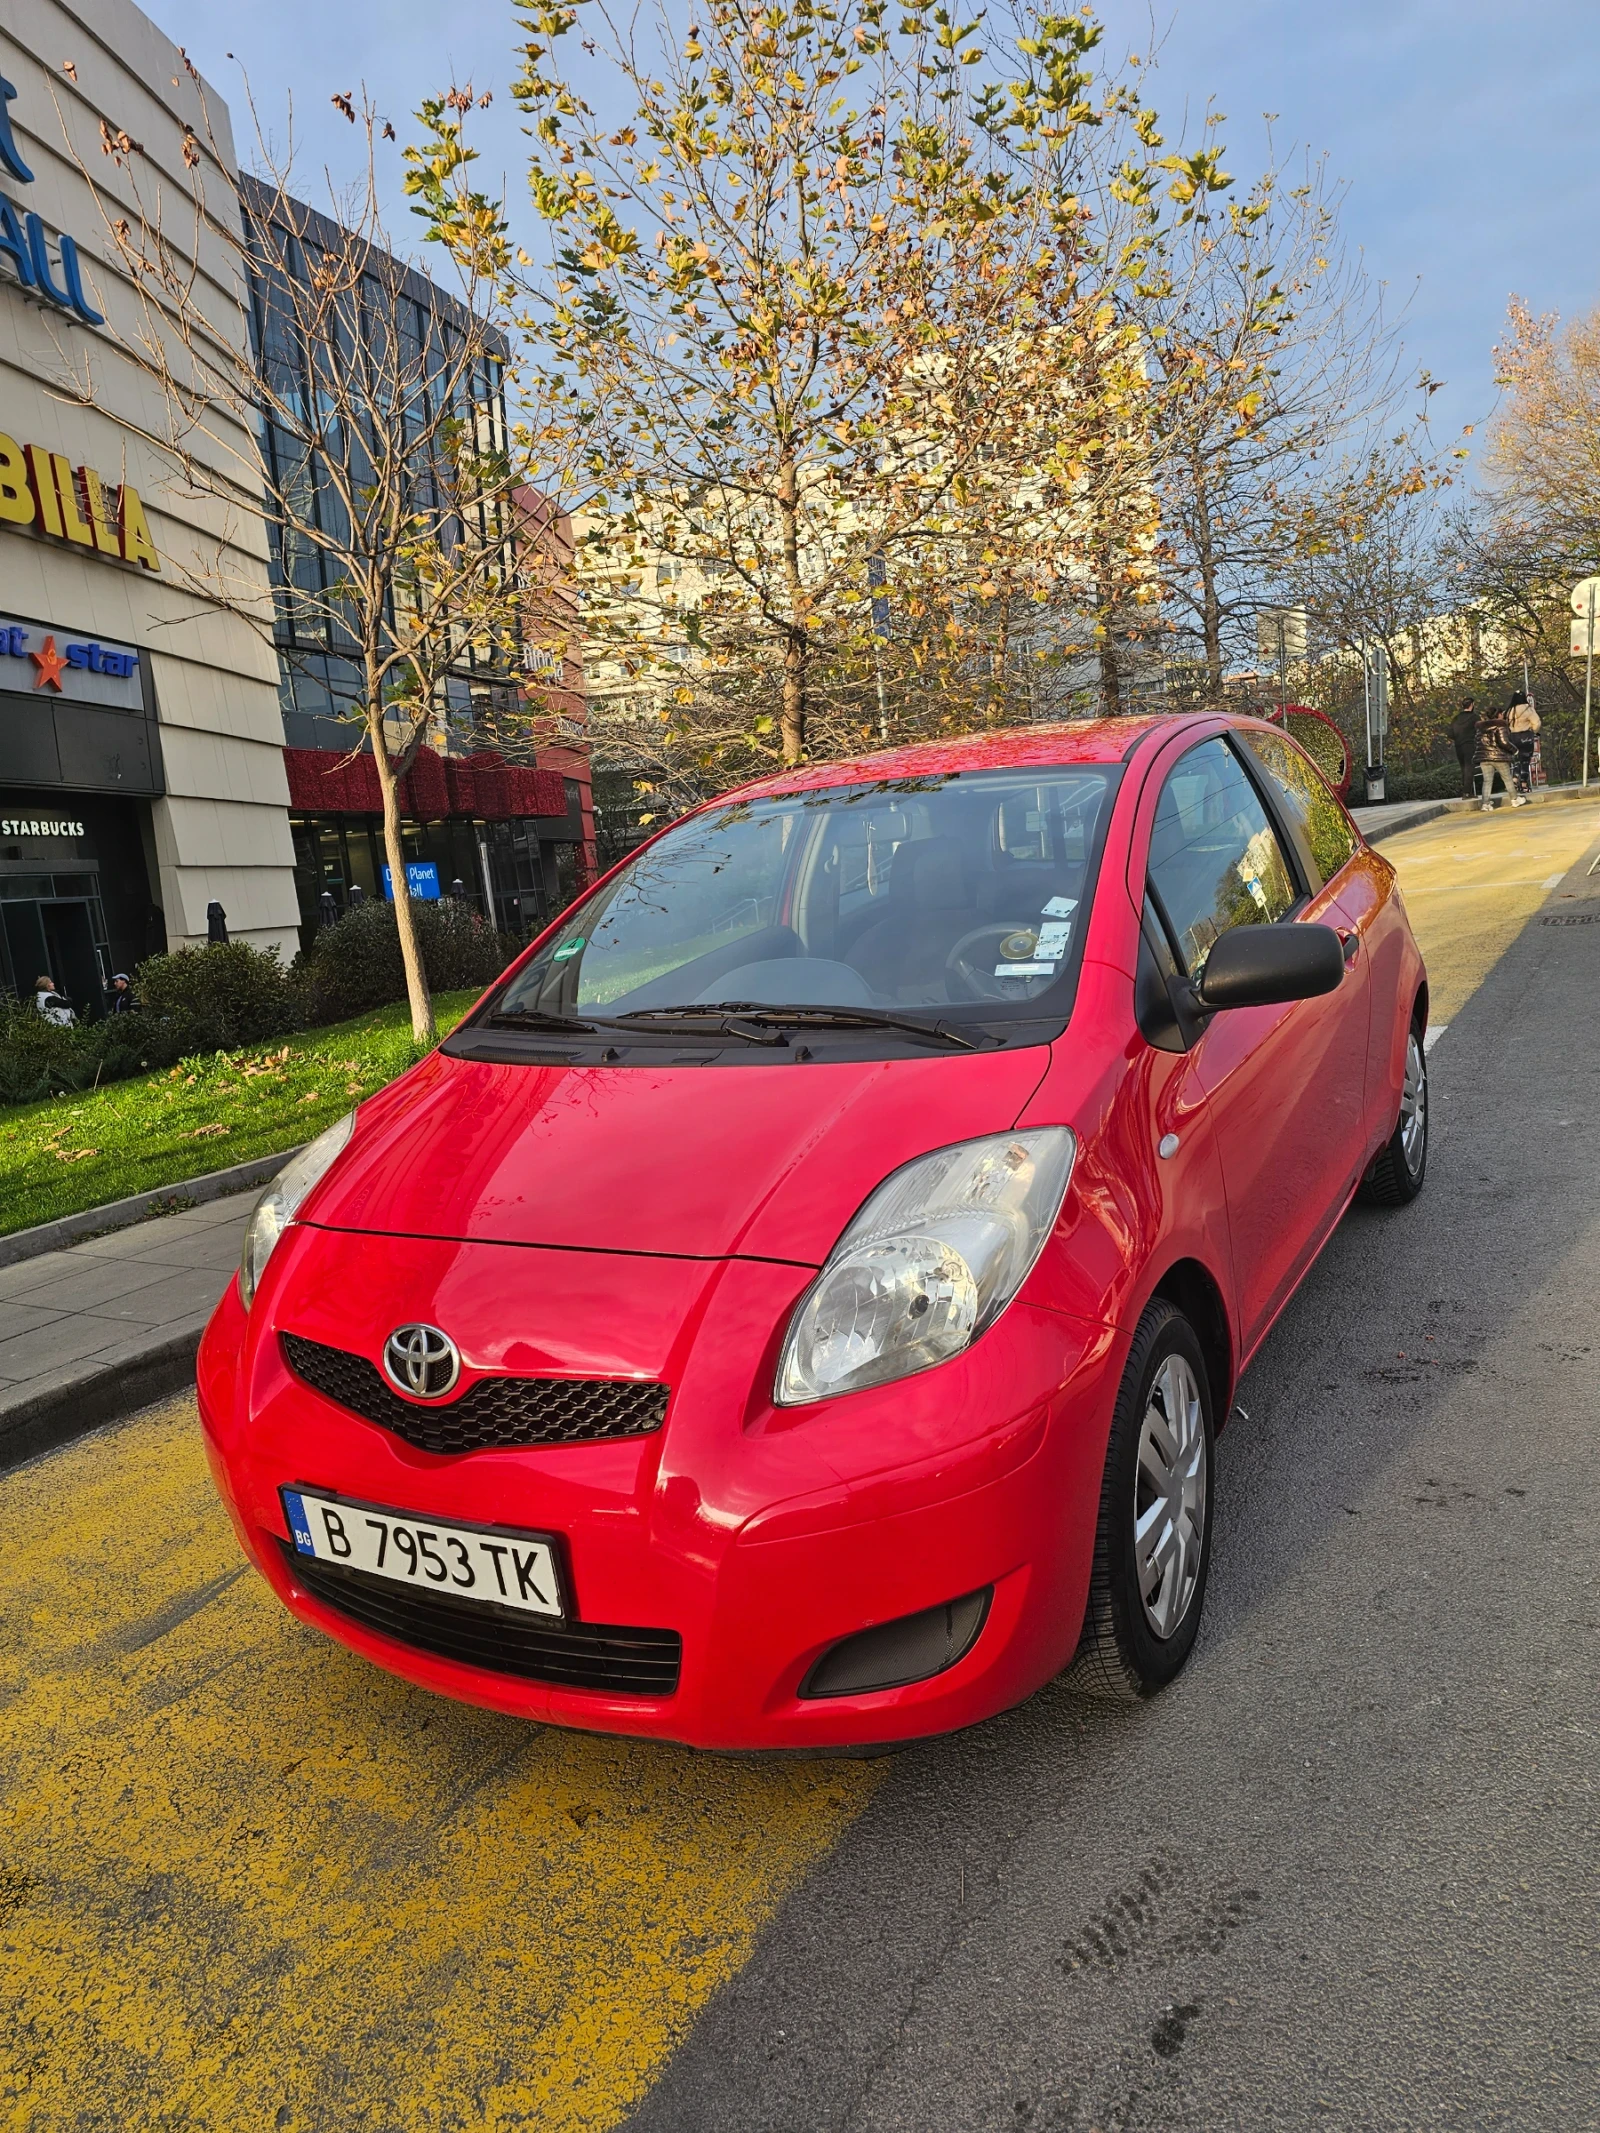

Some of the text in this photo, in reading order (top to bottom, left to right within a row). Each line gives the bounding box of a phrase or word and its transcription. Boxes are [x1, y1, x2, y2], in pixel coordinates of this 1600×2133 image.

[0, 431, 161, 572] BILLA
[66, 643, 140, 678] star
[1, 819, 85, 836] STARBUCKS
[409, 866, 435, 880] Planet
[296, 1529, 312, 1547] BG
[321, 1507, 550, 1605] B 7953 TK
